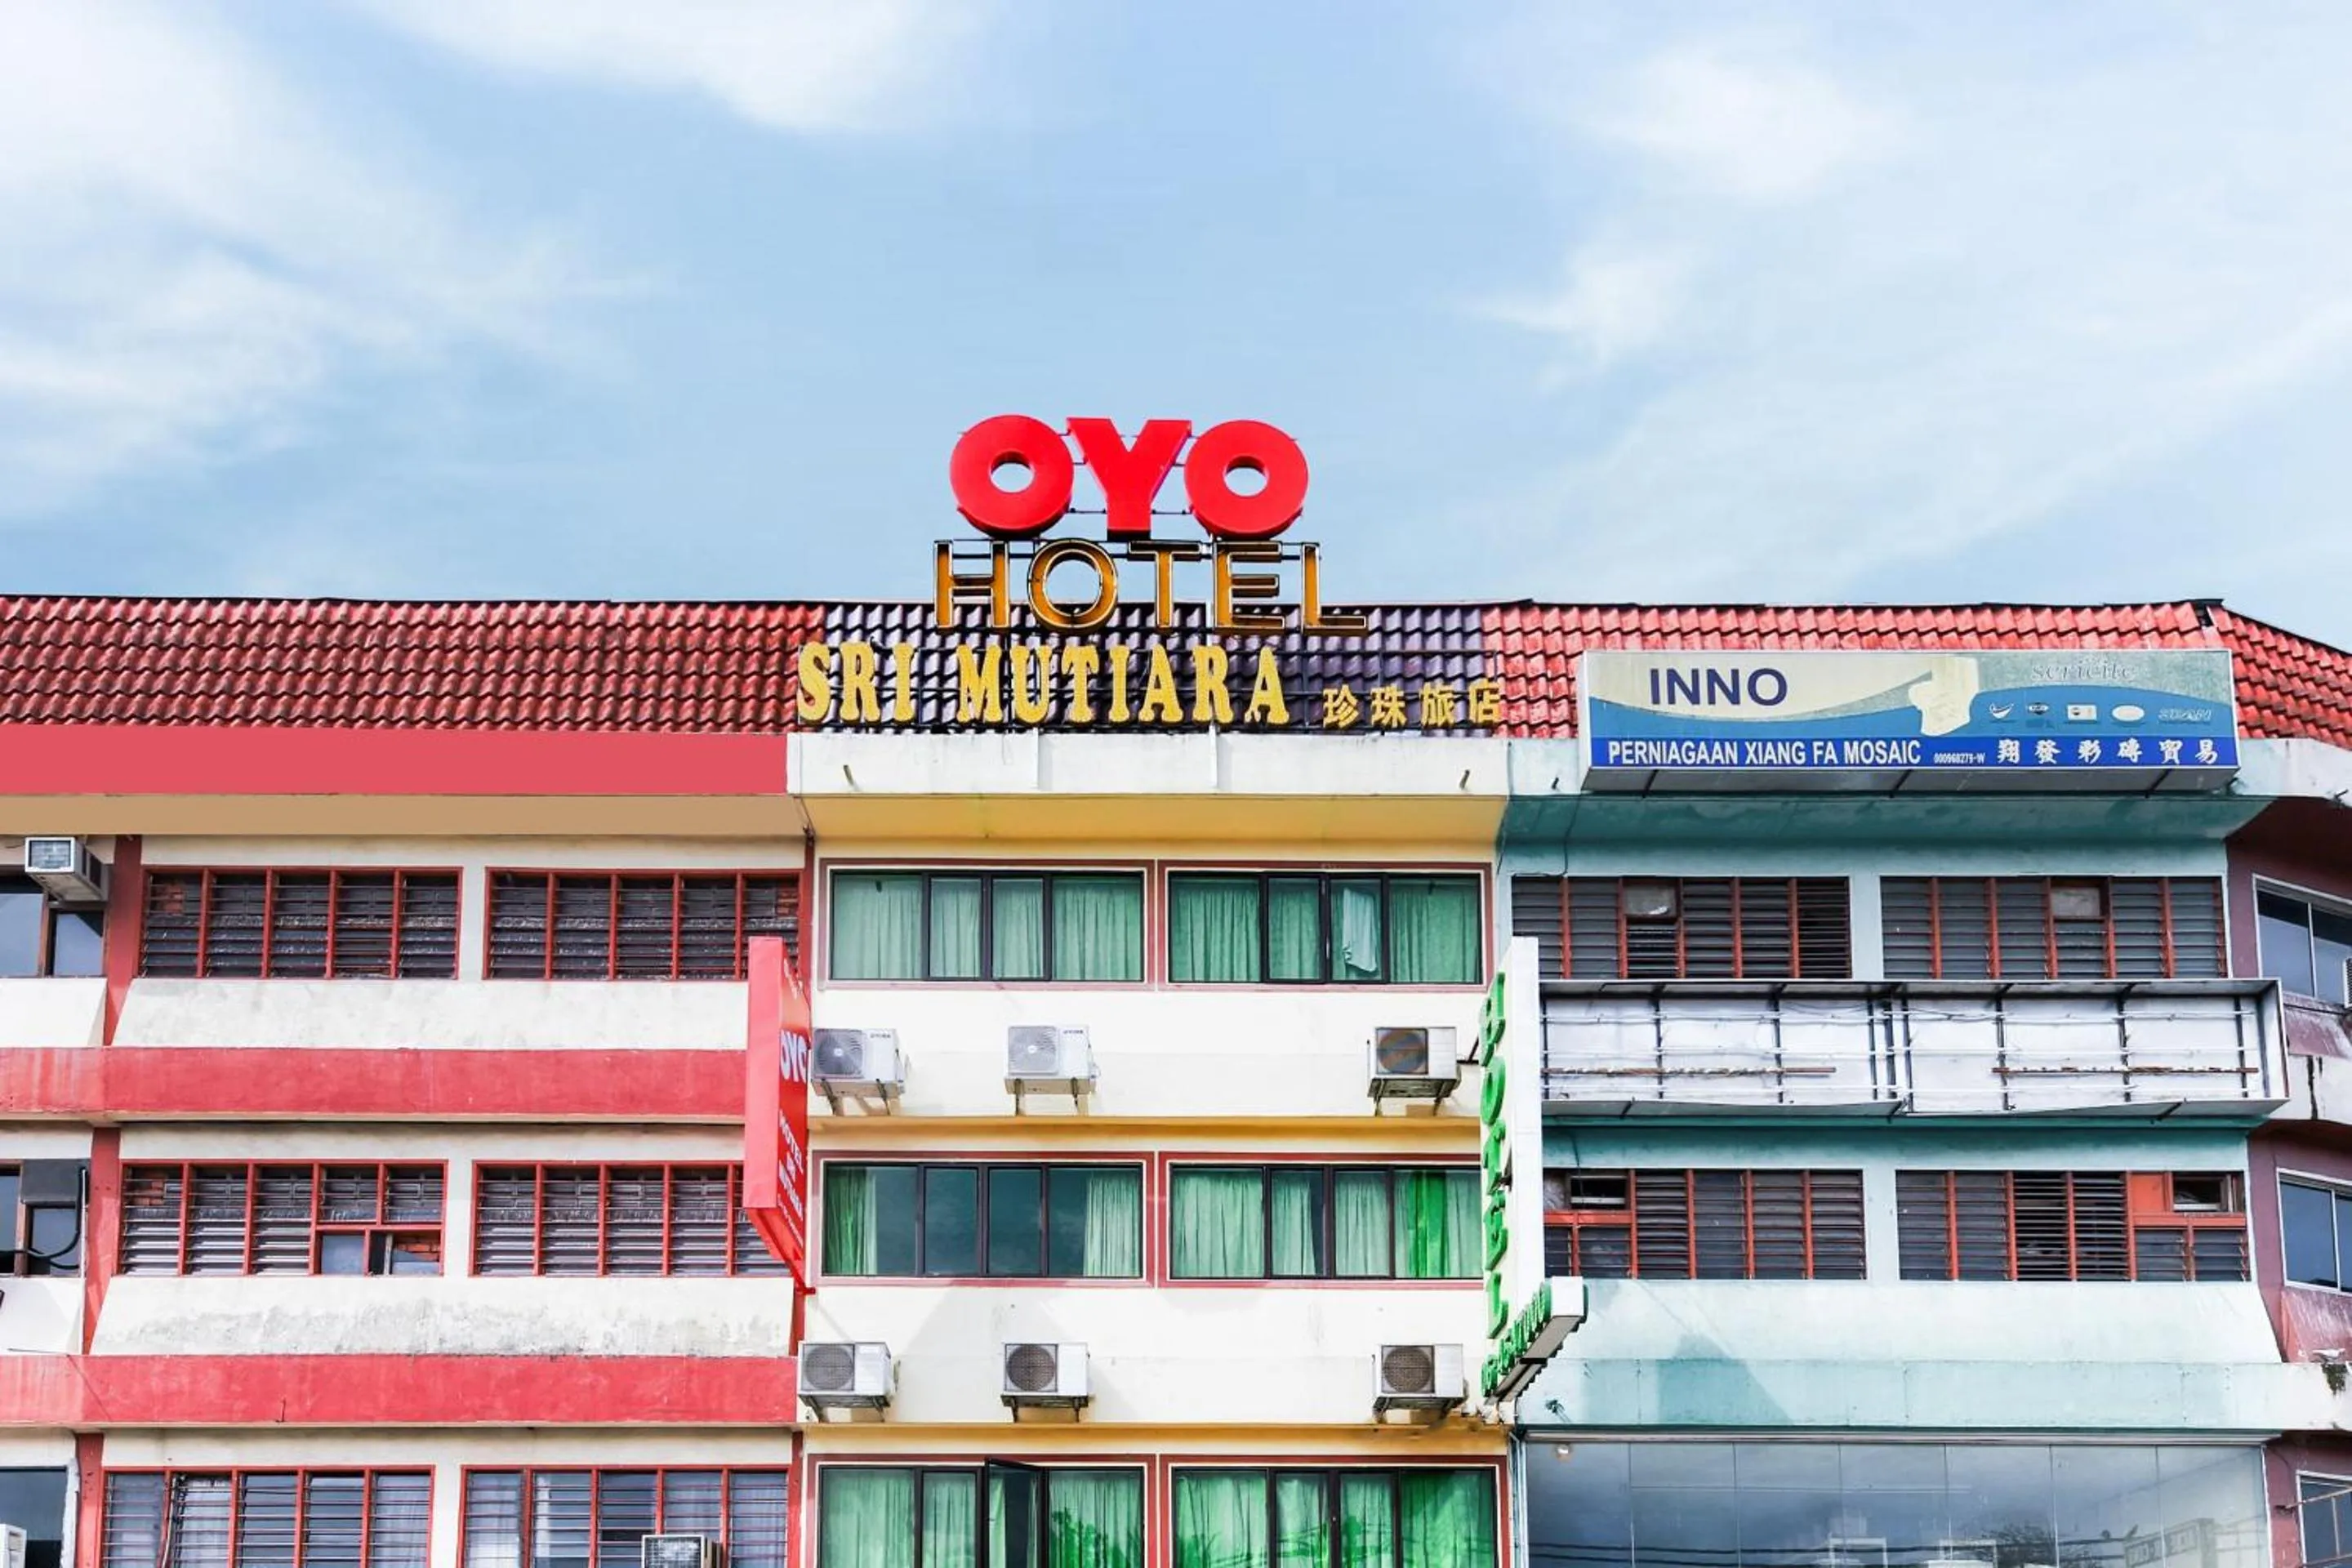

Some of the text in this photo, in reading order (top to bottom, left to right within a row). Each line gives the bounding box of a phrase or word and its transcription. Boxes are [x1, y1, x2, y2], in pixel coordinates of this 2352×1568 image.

[951, 415, 1309, 541] OYO
[933, 538, 1367, 635] HOTEL
[797, 640, 1290, 725] SRI MUTIARA
[1322, 679, 1501, 728] 珍珠旅店
[1649, 667, 1788, 706] INNO
[1608, 739, 1922, 766] PERNIAGAAN XIANG FA MOSAIC
